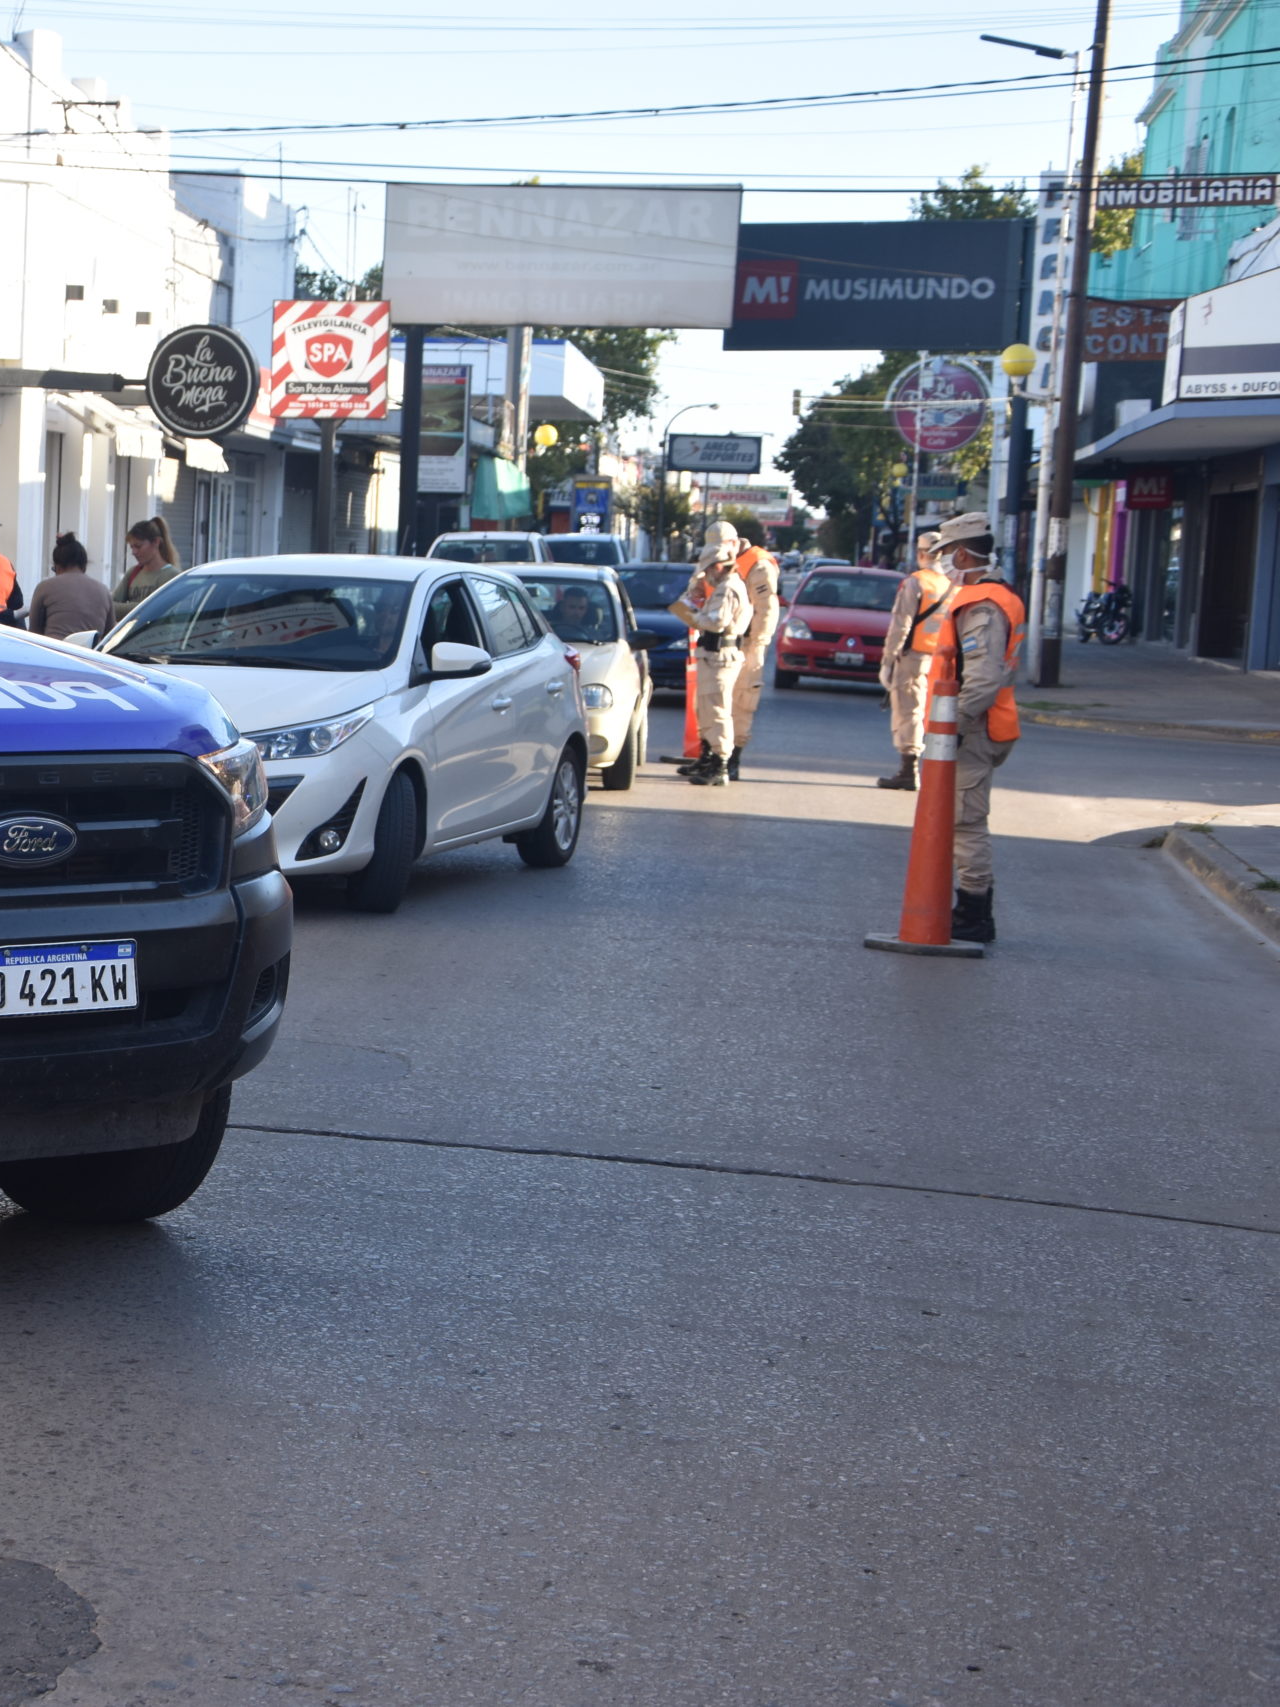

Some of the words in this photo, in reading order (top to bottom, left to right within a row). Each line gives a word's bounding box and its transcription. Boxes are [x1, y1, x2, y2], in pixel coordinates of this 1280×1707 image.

[1097, 178, 1273, 206] NMOBILIARIA
[406, 197, 714, 238] BENNAZAR
[441, 289, 664, 315] INMOBILIARIA
[742, 275, 791, 304] M!
[804, 277, 996, 301] MUSIMUNDO
[291, 318, 368, 336] TELEVIGILANCIA
[185, 335, 217, 367] La
[309, 342, 348, 363] SPA
[162, 354, 238, 387] Buena
[288, 382, 305, 393] San
[306, 382, 332, 394] Pedro
[333, 383, 369, 394] Alarmas
[1185, 383, 1227, 395] ABYSS
[1242, 382, 1280, 393] DUFO
[3, 824, 58, 853] Ford
[5, 955, 45, 966] REPUBLICA
[46, 952, 88, 963] ARGENTINA
[19, 967, 79, 1007] 421
[90, 963, 128, 1003] KW
